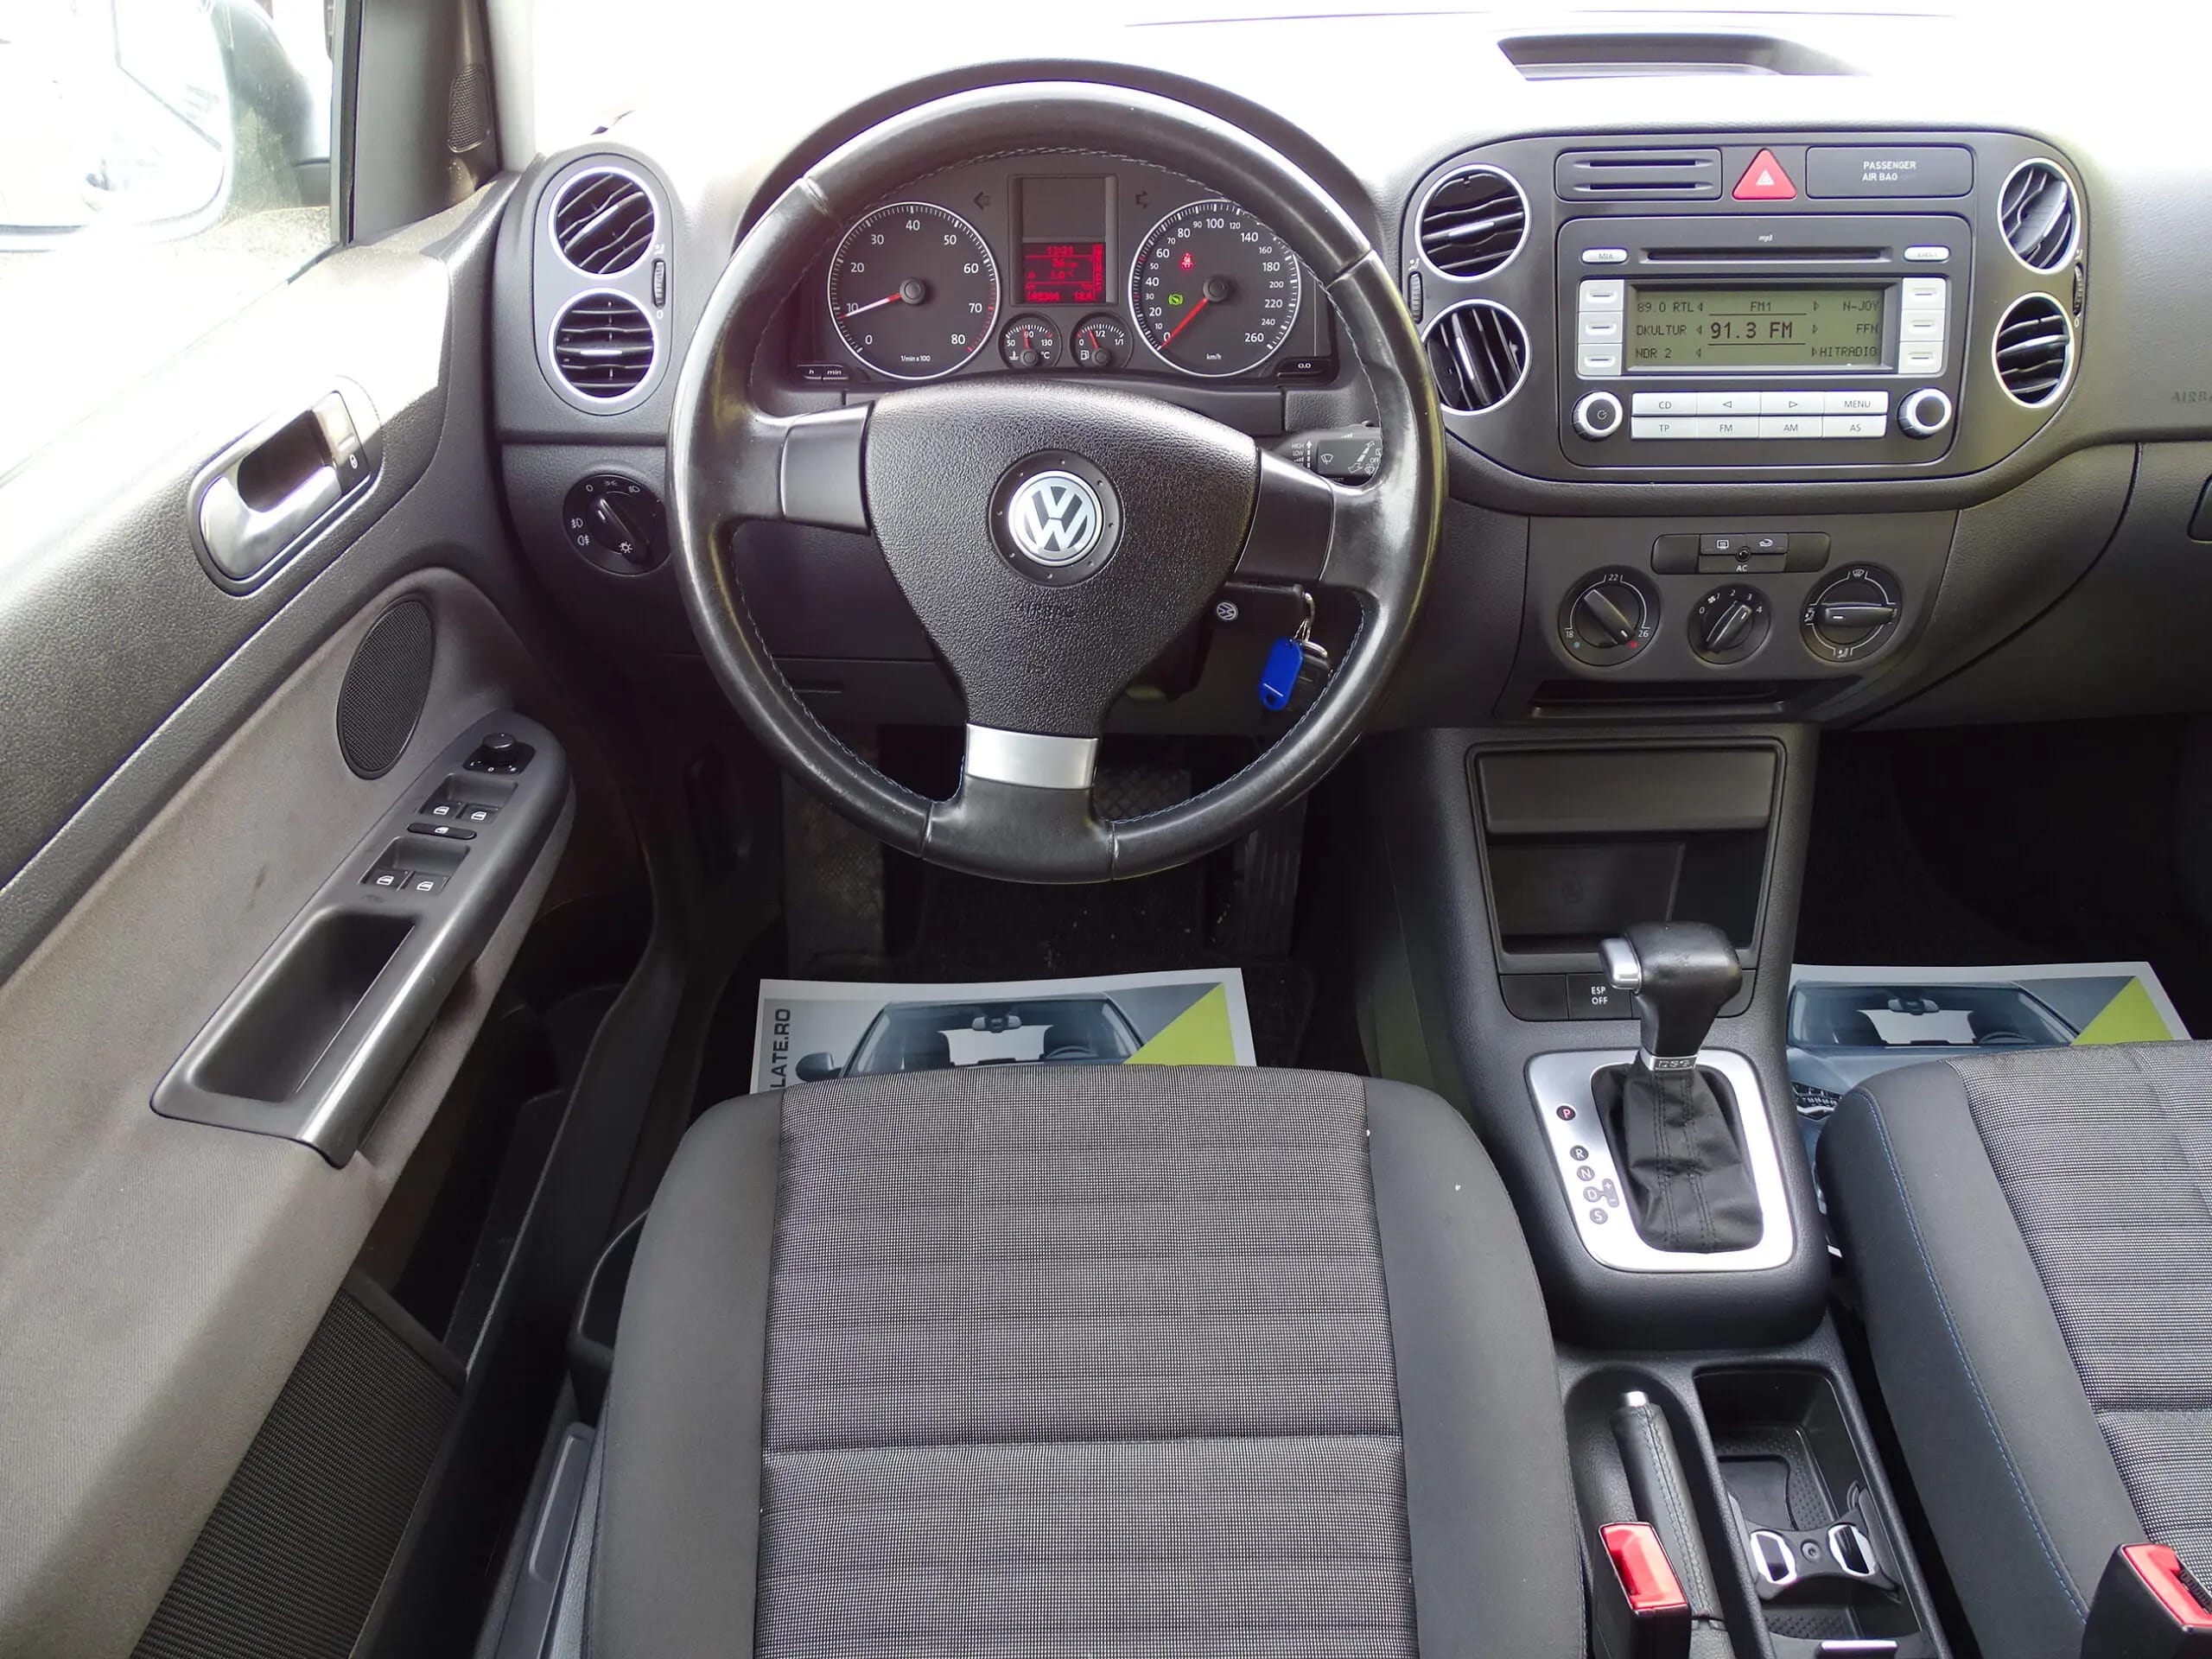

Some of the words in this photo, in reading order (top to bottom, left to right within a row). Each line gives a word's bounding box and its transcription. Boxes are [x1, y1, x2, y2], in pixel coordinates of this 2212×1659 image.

[1863, 161, 1916, 170] PASSENGER
[1862, 173, 1877, 181] AIR
[906, 220, 919, 231] 40
[1206, 219, 1224, 229] 100
[1178, 228, 1191, 238] 80
[1241, 232, 1258, 243] 140
[872, 235, 884, 245] 30
[944, 235, 957, 245] 50
[1156, 249, 1170, 258] 60
[850, 263, 864, 273] 20
[964, 264, 978, 273] 60
[1263, 262, 1280, 271] 180
[1146, 277, 1159, 286] 40
[848, 303, 858, 313] 10
[969, 304, 982, 313] 70
[1265, 299, 1282, 308] 220
[1673, 302, 1694, 312] RTL
[1750, 301, 1772, 312] FM1
[1843, 301, 1879, 311] N-JOY
[1149, 308, 1161, 316] 20
[1637, 325, 1687, 335] DKULTUR
[1711, 321, 1757, 339] 91.3
[1770, 321, 1792, 339] FM
[1856, 323, 1878, 334] FFN
[866, 335, 873, 344] 0
[951, 335, 965, 344] 80
[1164, 333, 1171, 341] 0
[1245, 333, 1264, 342] 260
[1636, 347, 1657, 358] NDR
[1664, 347, 1672, 358] 2
[1820, 346, 1877, 357] HITRADIO
[1608, 573, 1618, 582] 22
[1591, 986, 1606, 995] ESP
[1592, 996, 1608, 1005] OFF
[1562, 1109, 1571, 1118] P
[1575, 1148, 1585, 1158] R
[1580, 1169, 1591, 1179] N
[1587, 1190, 1597, 1199] D
[1594, 1211, 1602, 1221] S
